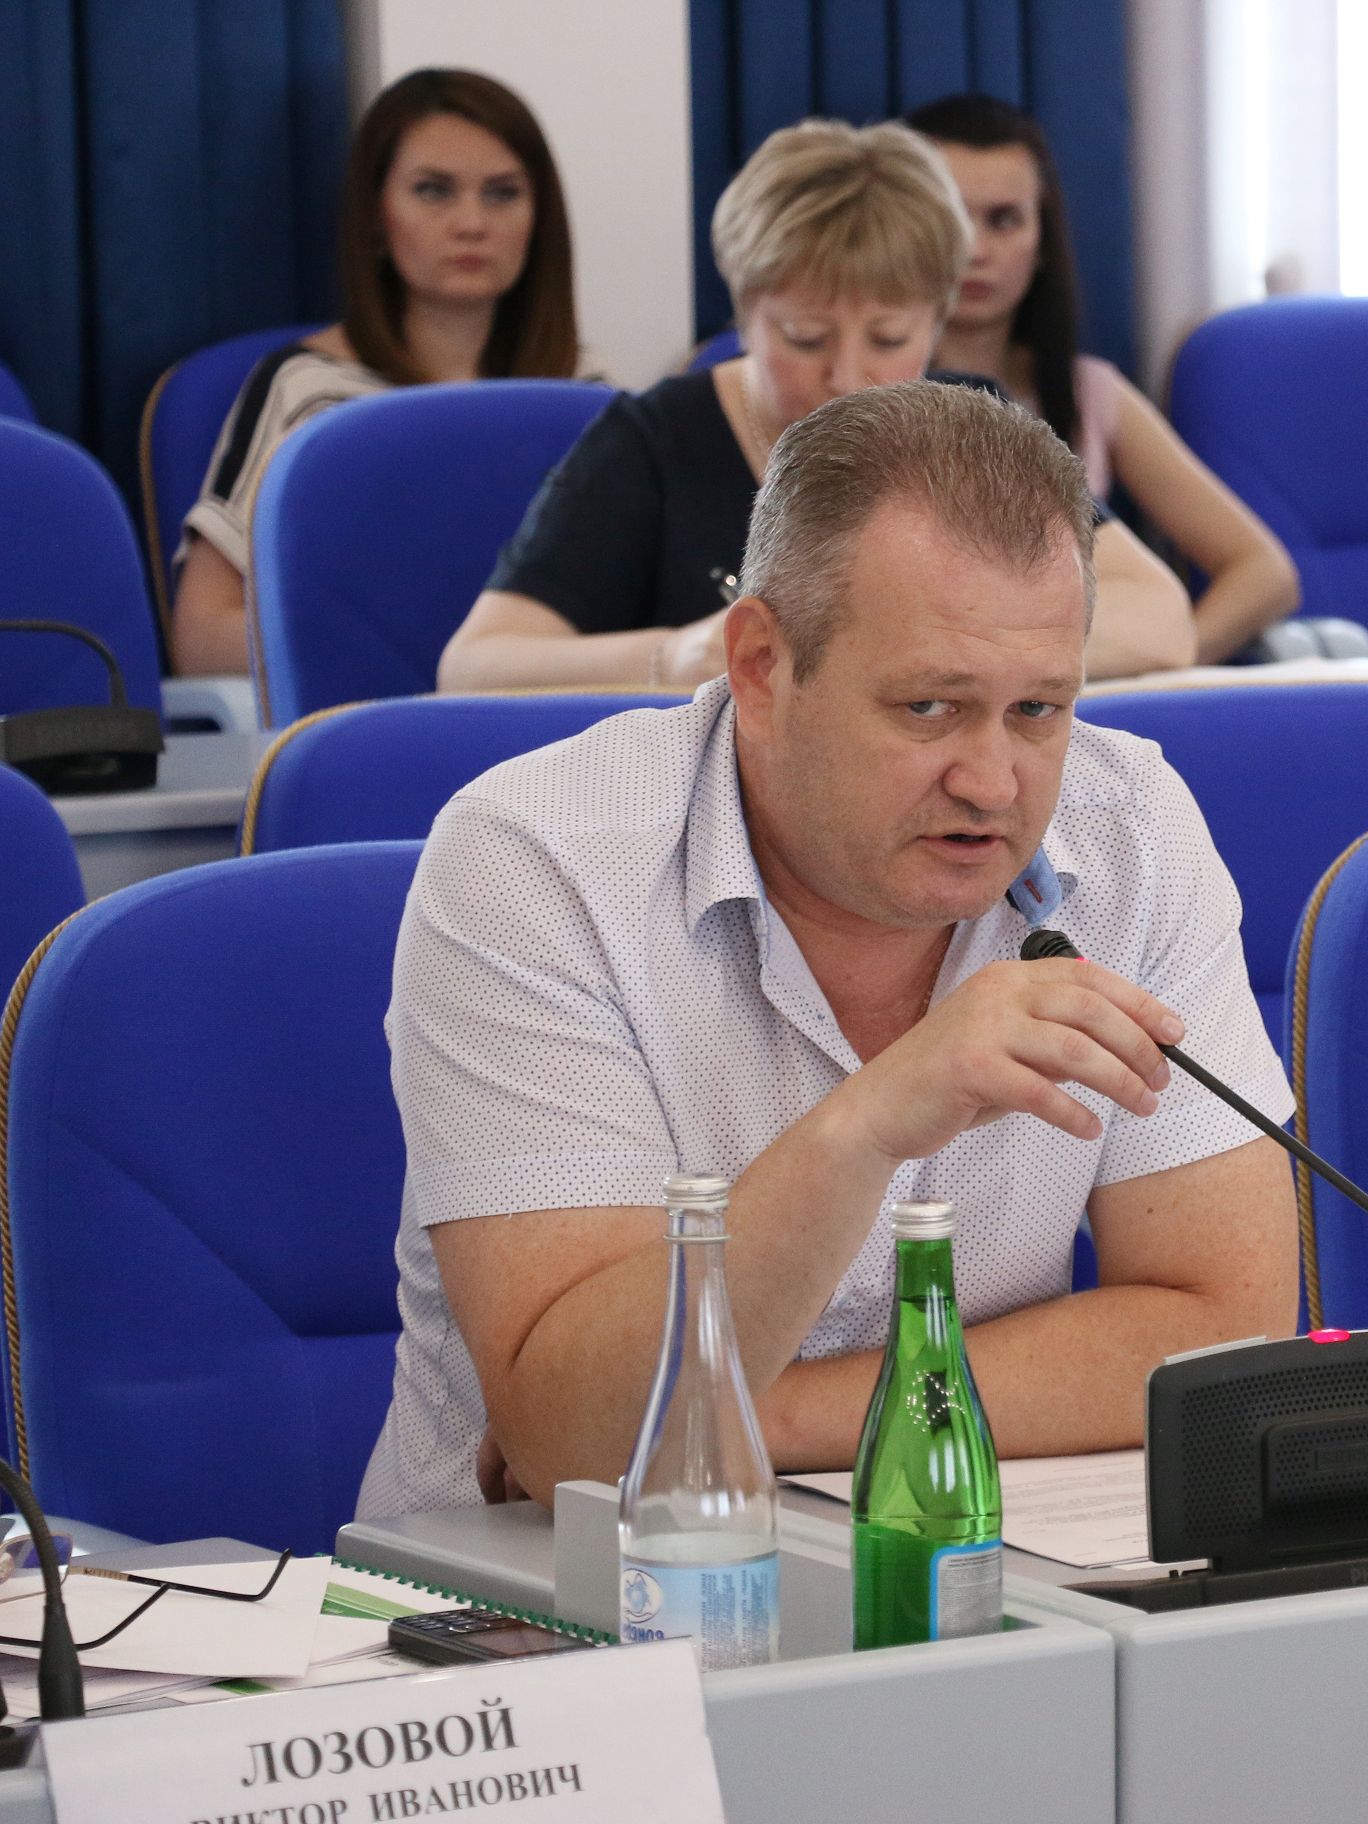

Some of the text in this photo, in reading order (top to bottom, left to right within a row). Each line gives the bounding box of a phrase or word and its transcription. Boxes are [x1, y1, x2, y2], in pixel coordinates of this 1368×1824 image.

[241, 1697, 520, 1788] ЛОЗОВОЙ
[189, 1763, 584, 1824] КТОР ИВАНОВИЧ
